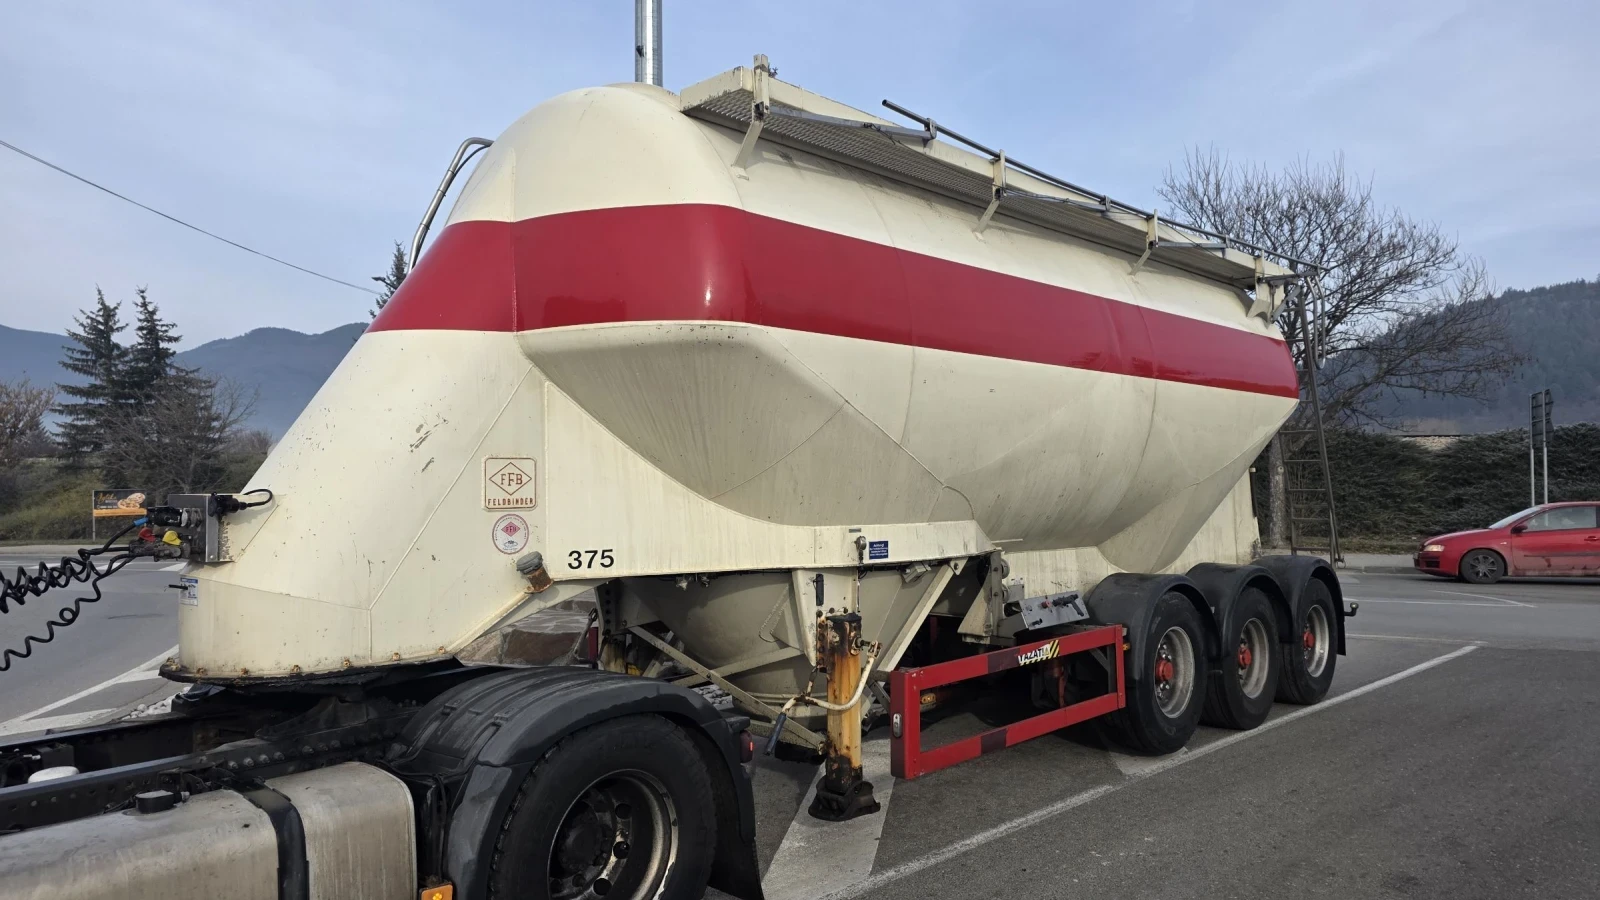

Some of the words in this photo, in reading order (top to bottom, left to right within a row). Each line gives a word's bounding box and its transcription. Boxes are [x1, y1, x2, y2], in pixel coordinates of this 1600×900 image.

[500, 472, 523, 486] FFB
[487, 497, 534, 506] FELDBINDER
[567, 549, 615, 570] 375
